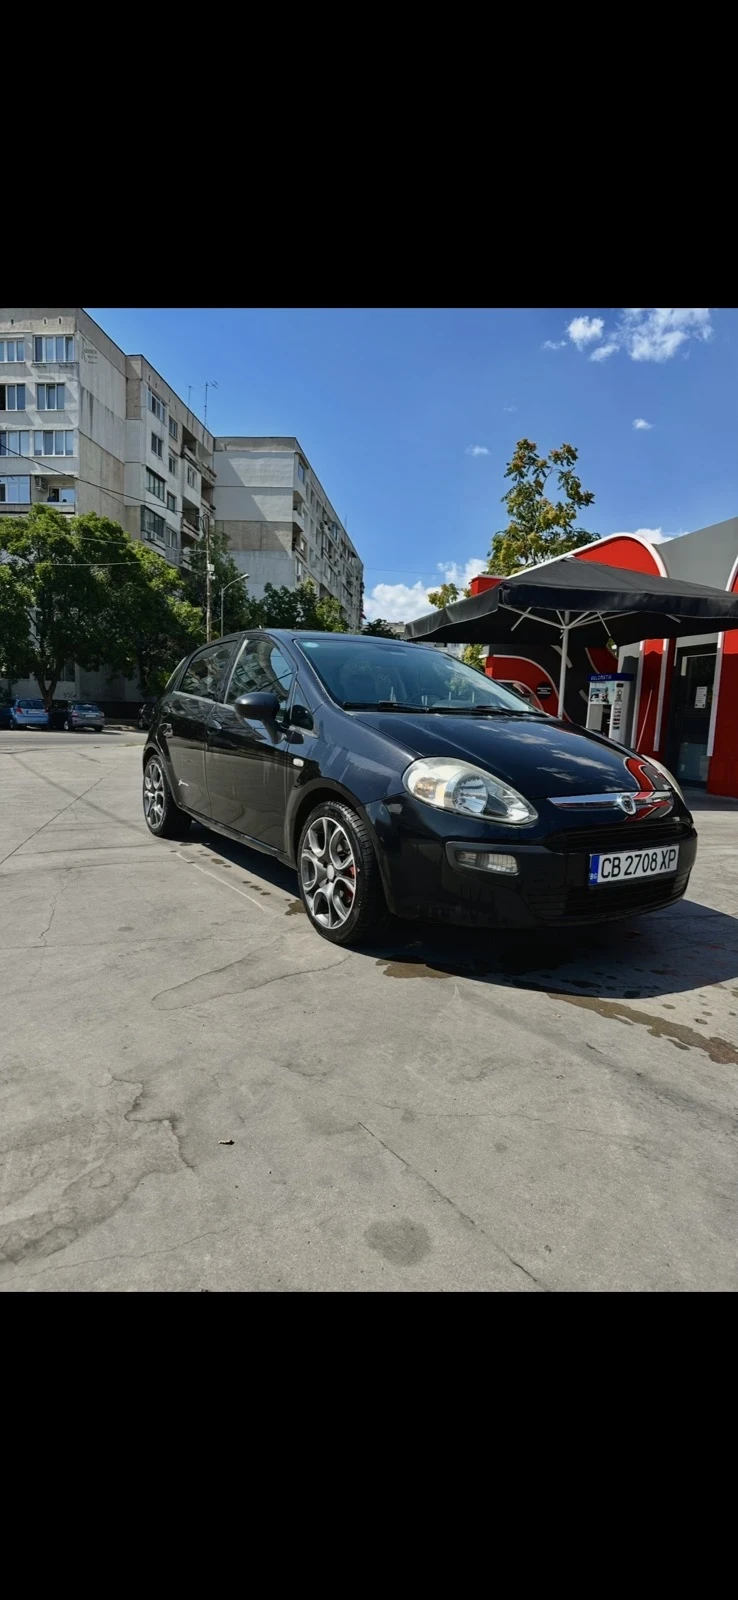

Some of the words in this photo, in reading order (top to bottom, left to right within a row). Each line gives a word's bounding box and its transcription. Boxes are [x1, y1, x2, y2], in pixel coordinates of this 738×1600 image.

[601, 857, 621, 878] CB
[624, 852, 658, 876] 2708
[660, 849, 676, 870] XP
